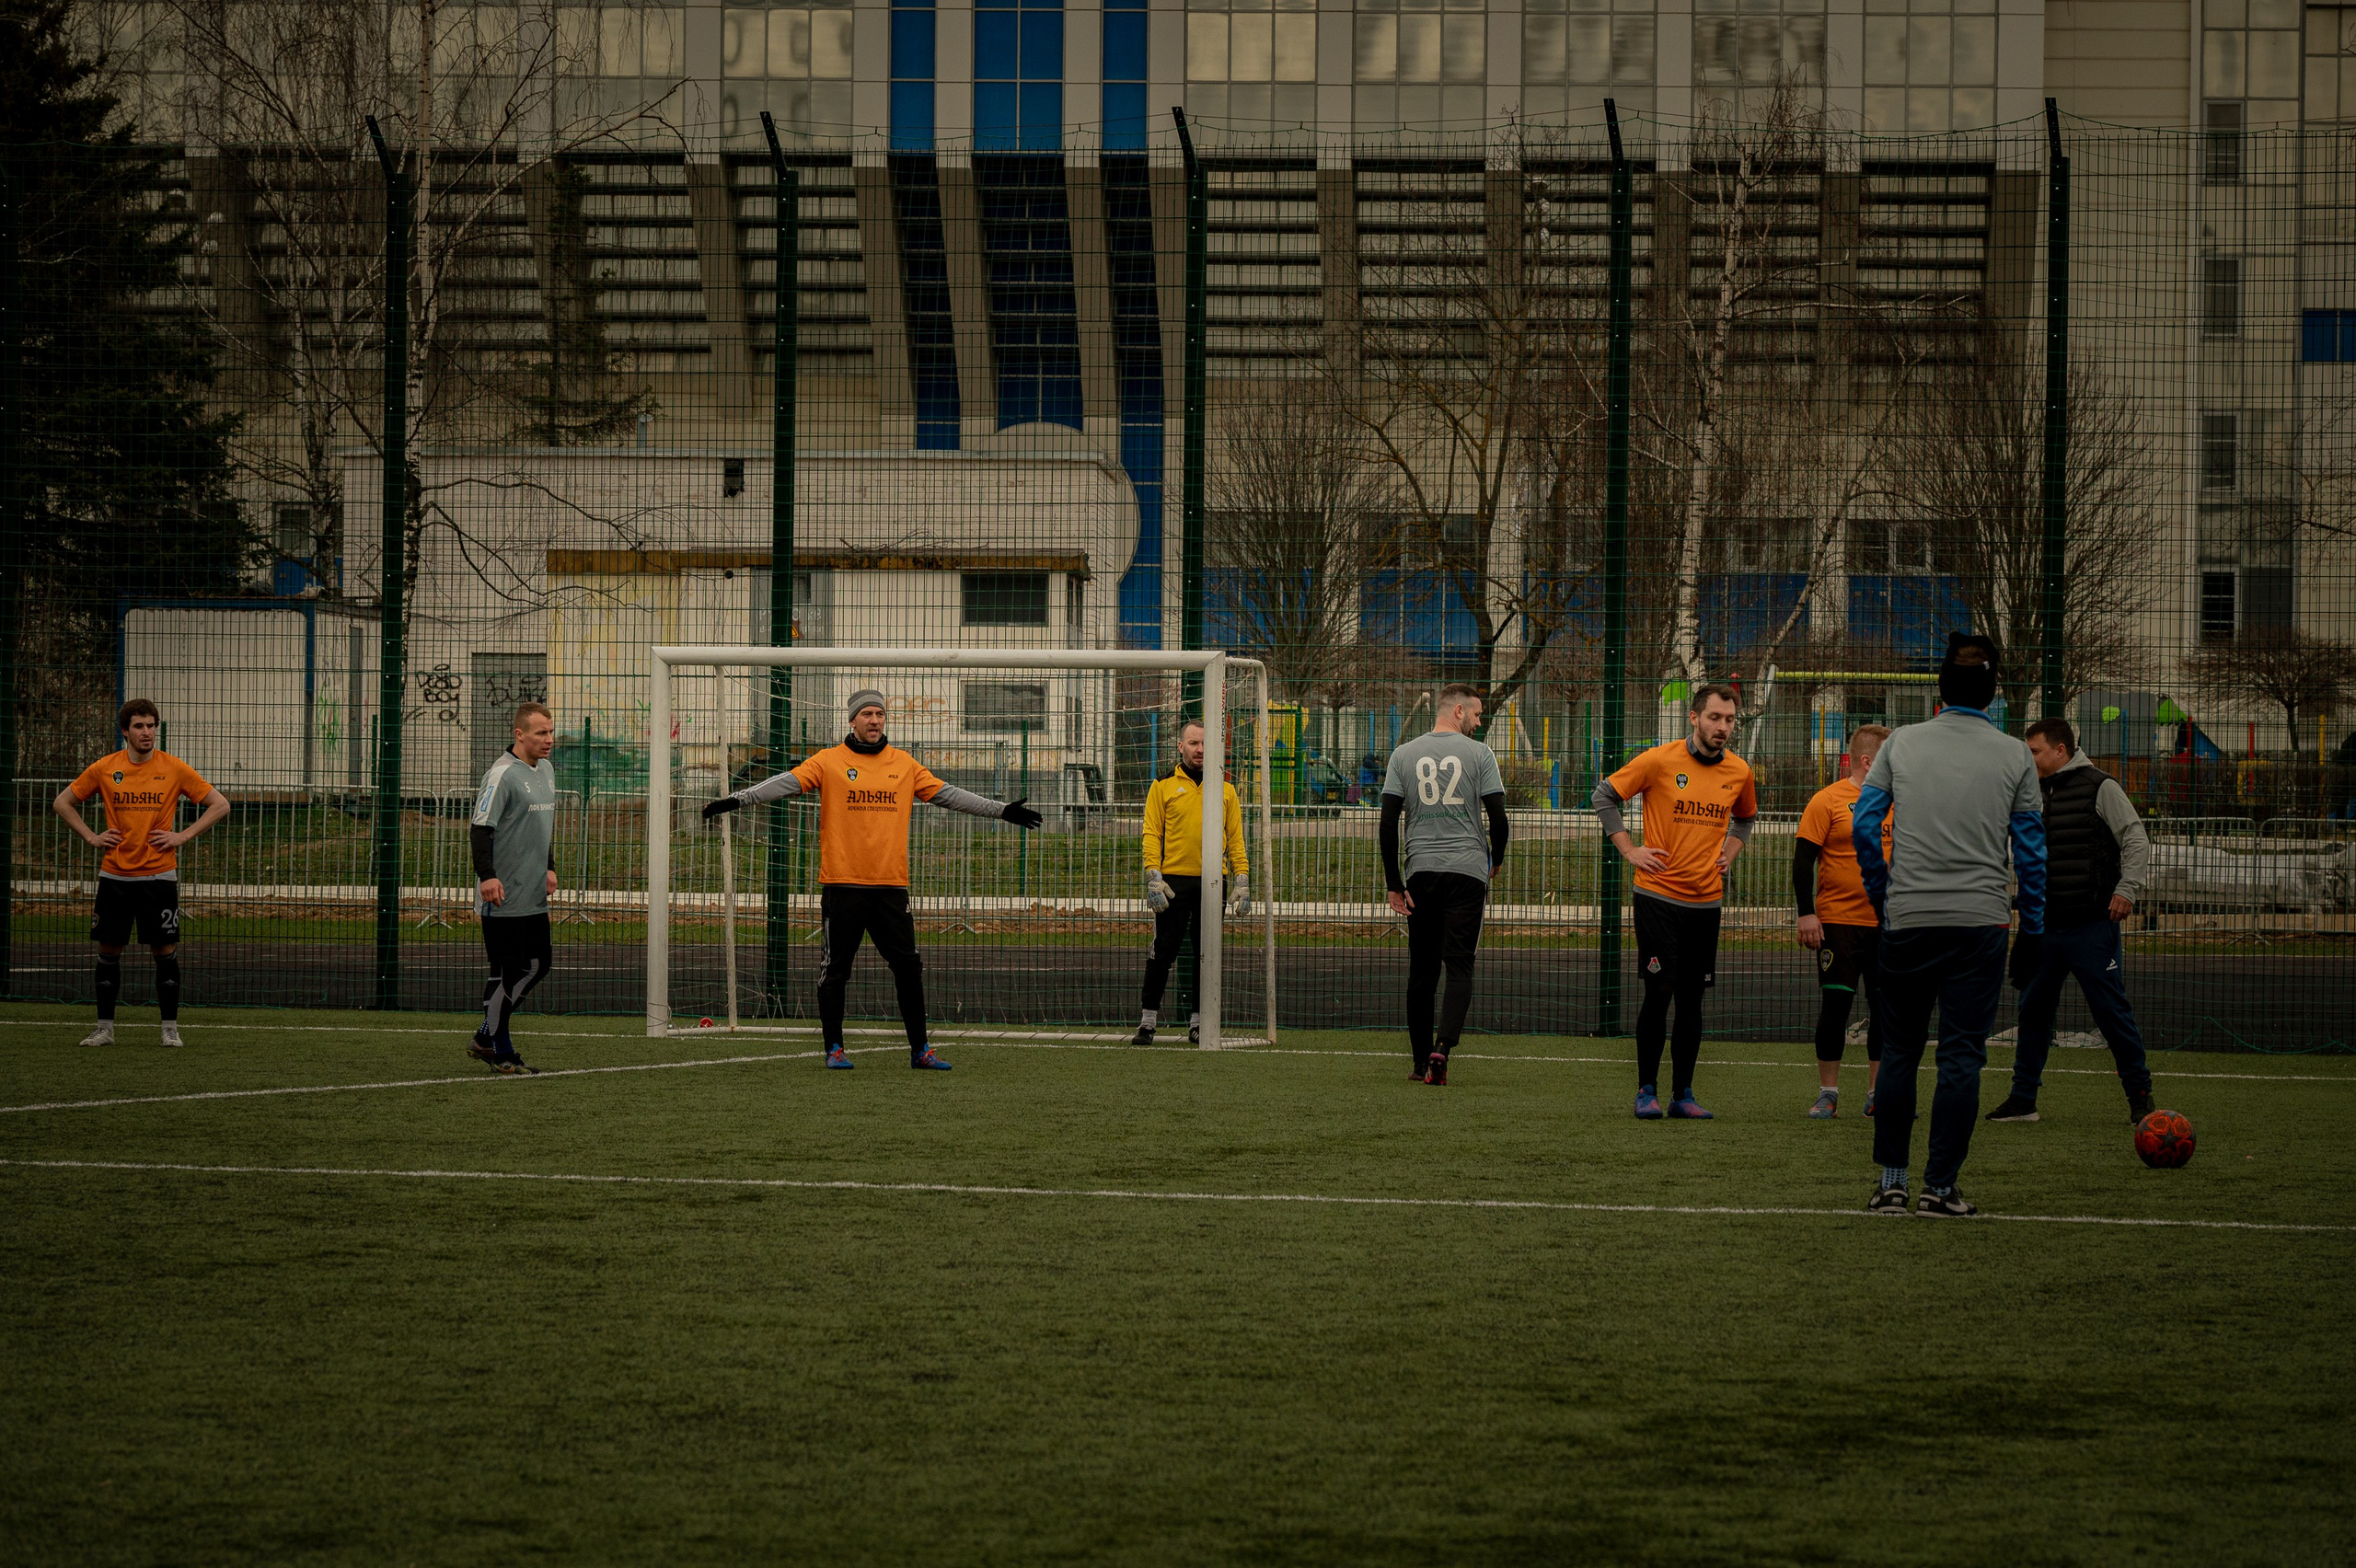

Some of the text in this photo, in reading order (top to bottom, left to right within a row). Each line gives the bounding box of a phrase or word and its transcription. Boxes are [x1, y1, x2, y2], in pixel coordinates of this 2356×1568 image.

[524, 781, 531, 793] 5
[1415, 755, 1464, 805] 82
[112, 791, 164, 805] АЛЬЯНС
[846, 790, 897, 804] АЛЬЯНС
[1416, 811, 1469, 821] vniissok.com
[160, 907, 179, 928] 26
